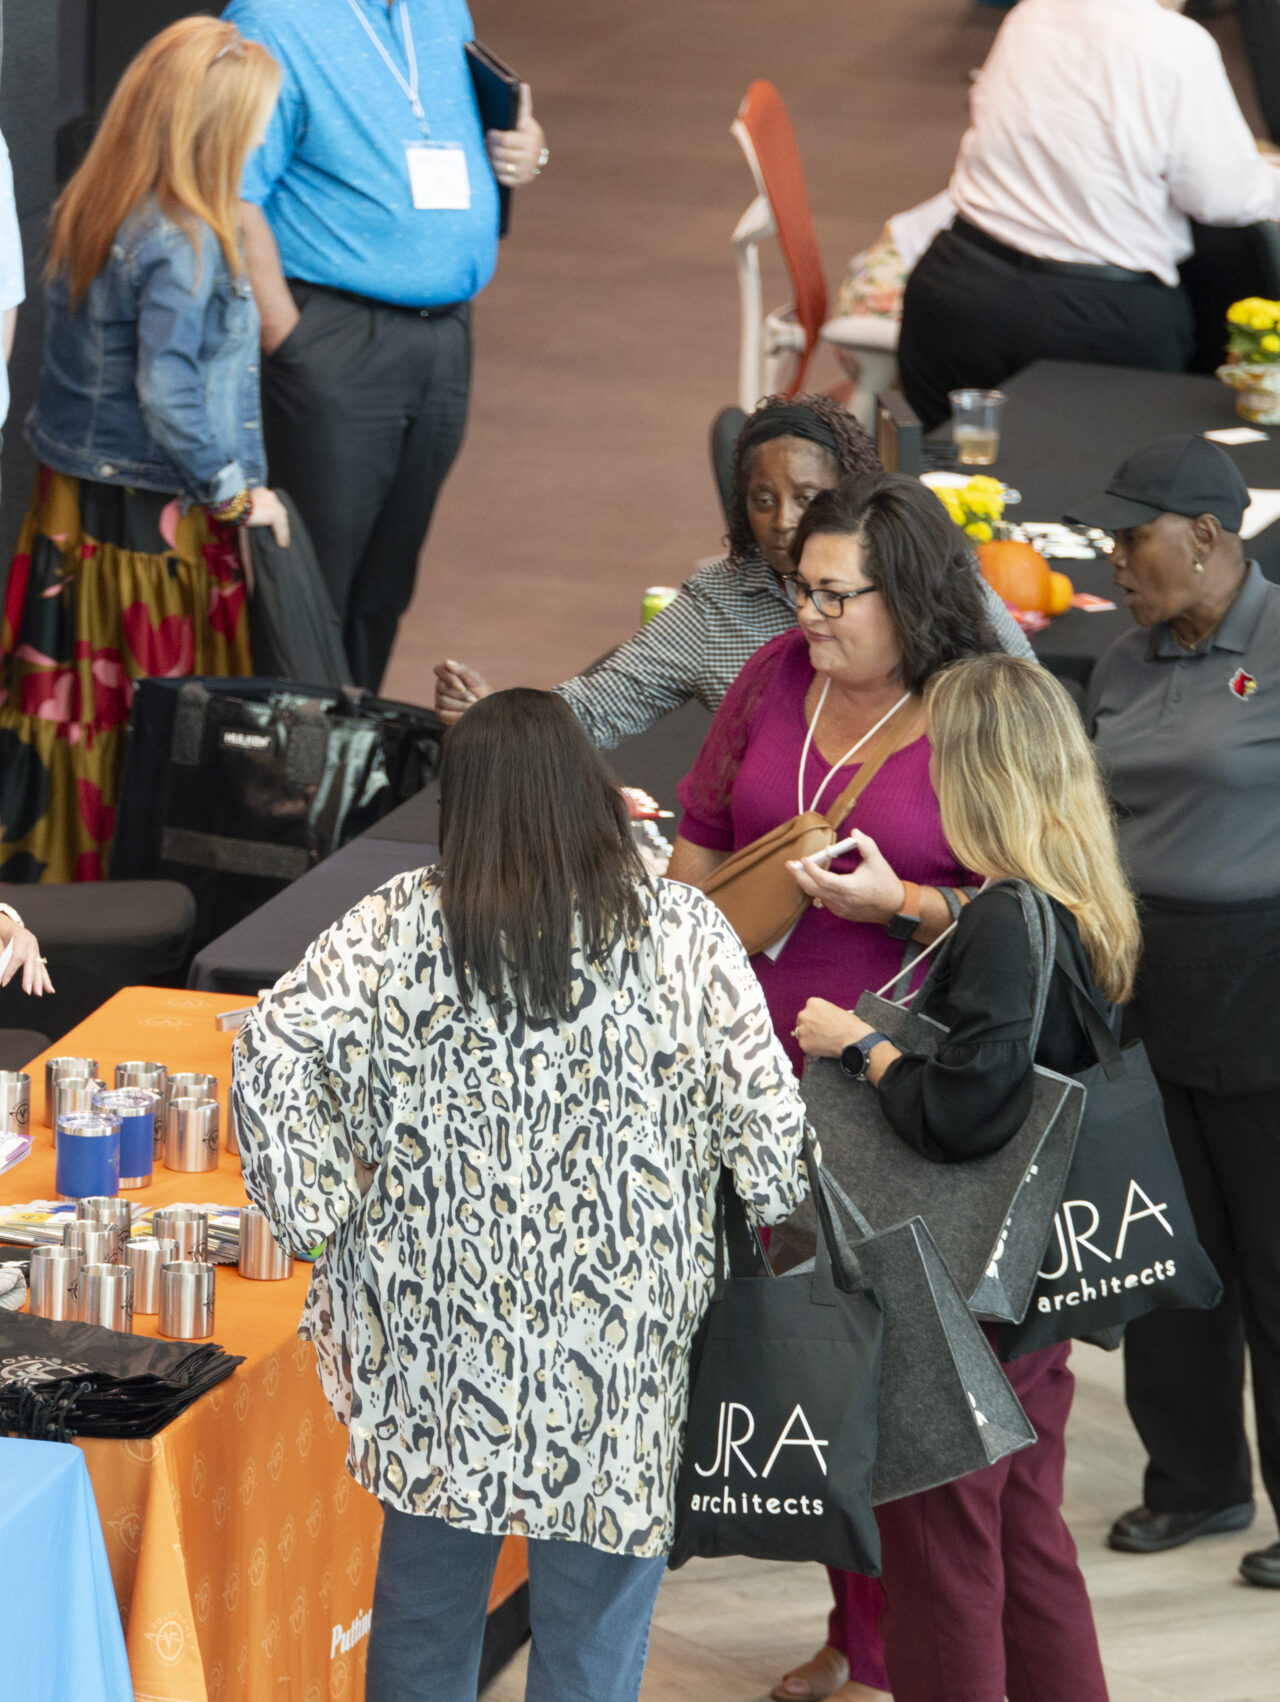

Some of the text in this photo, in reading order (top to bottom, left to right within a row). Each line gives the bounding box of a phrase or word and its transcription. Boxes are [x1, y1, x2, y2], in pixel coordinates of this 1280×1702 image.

[1037, 1179, 1174, 1280] JRA
[1037, 1259, 1176, 1313] architects
[694, 1401, 829, 1478] JRA
[690, 1485, 824, 1515] architects
